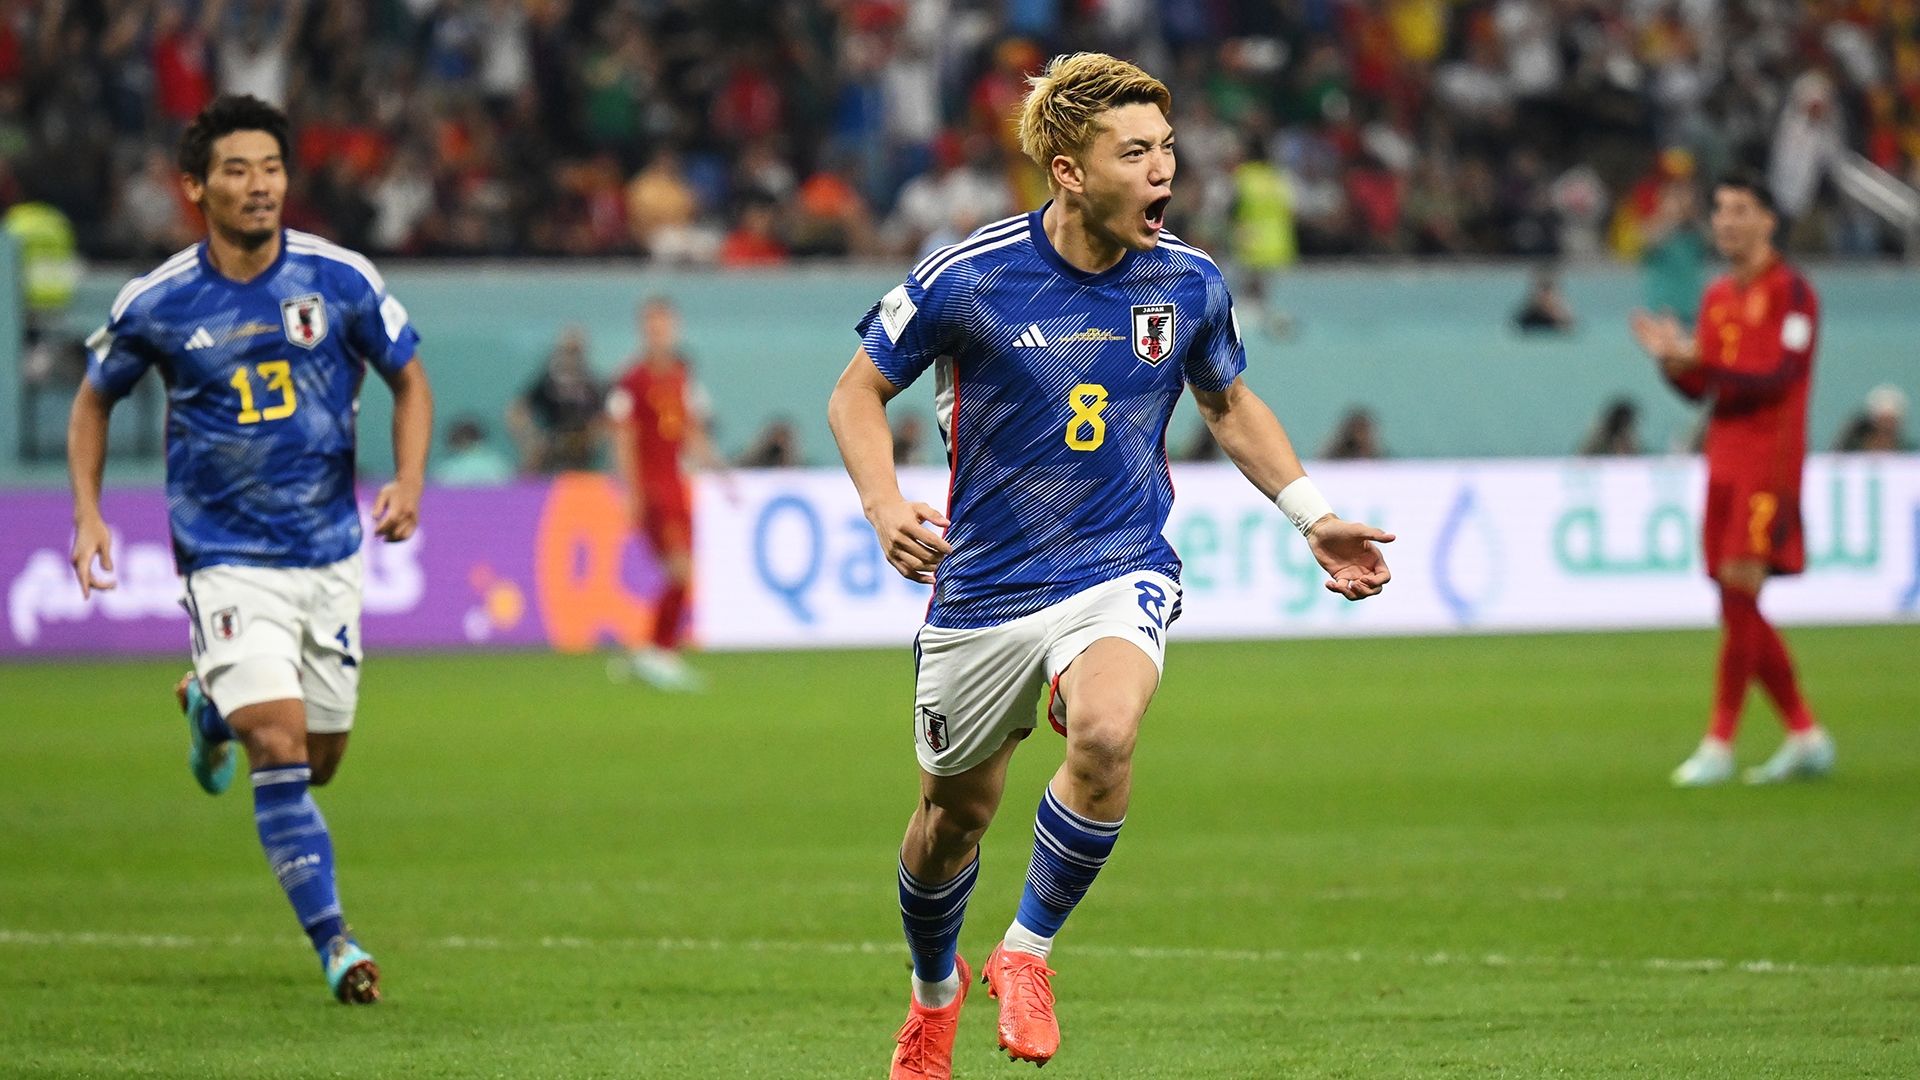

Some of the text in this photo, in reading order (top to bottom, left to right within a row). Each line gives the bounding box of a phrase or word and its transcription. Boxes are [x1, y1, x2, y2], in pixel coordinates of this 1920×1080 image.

[1145, 345, 1163, 355] JFA
[230, 360, 297, 424] 13
[1065, 384, 1108, 451] 8
[1134, 579, 1167, 629] 8
